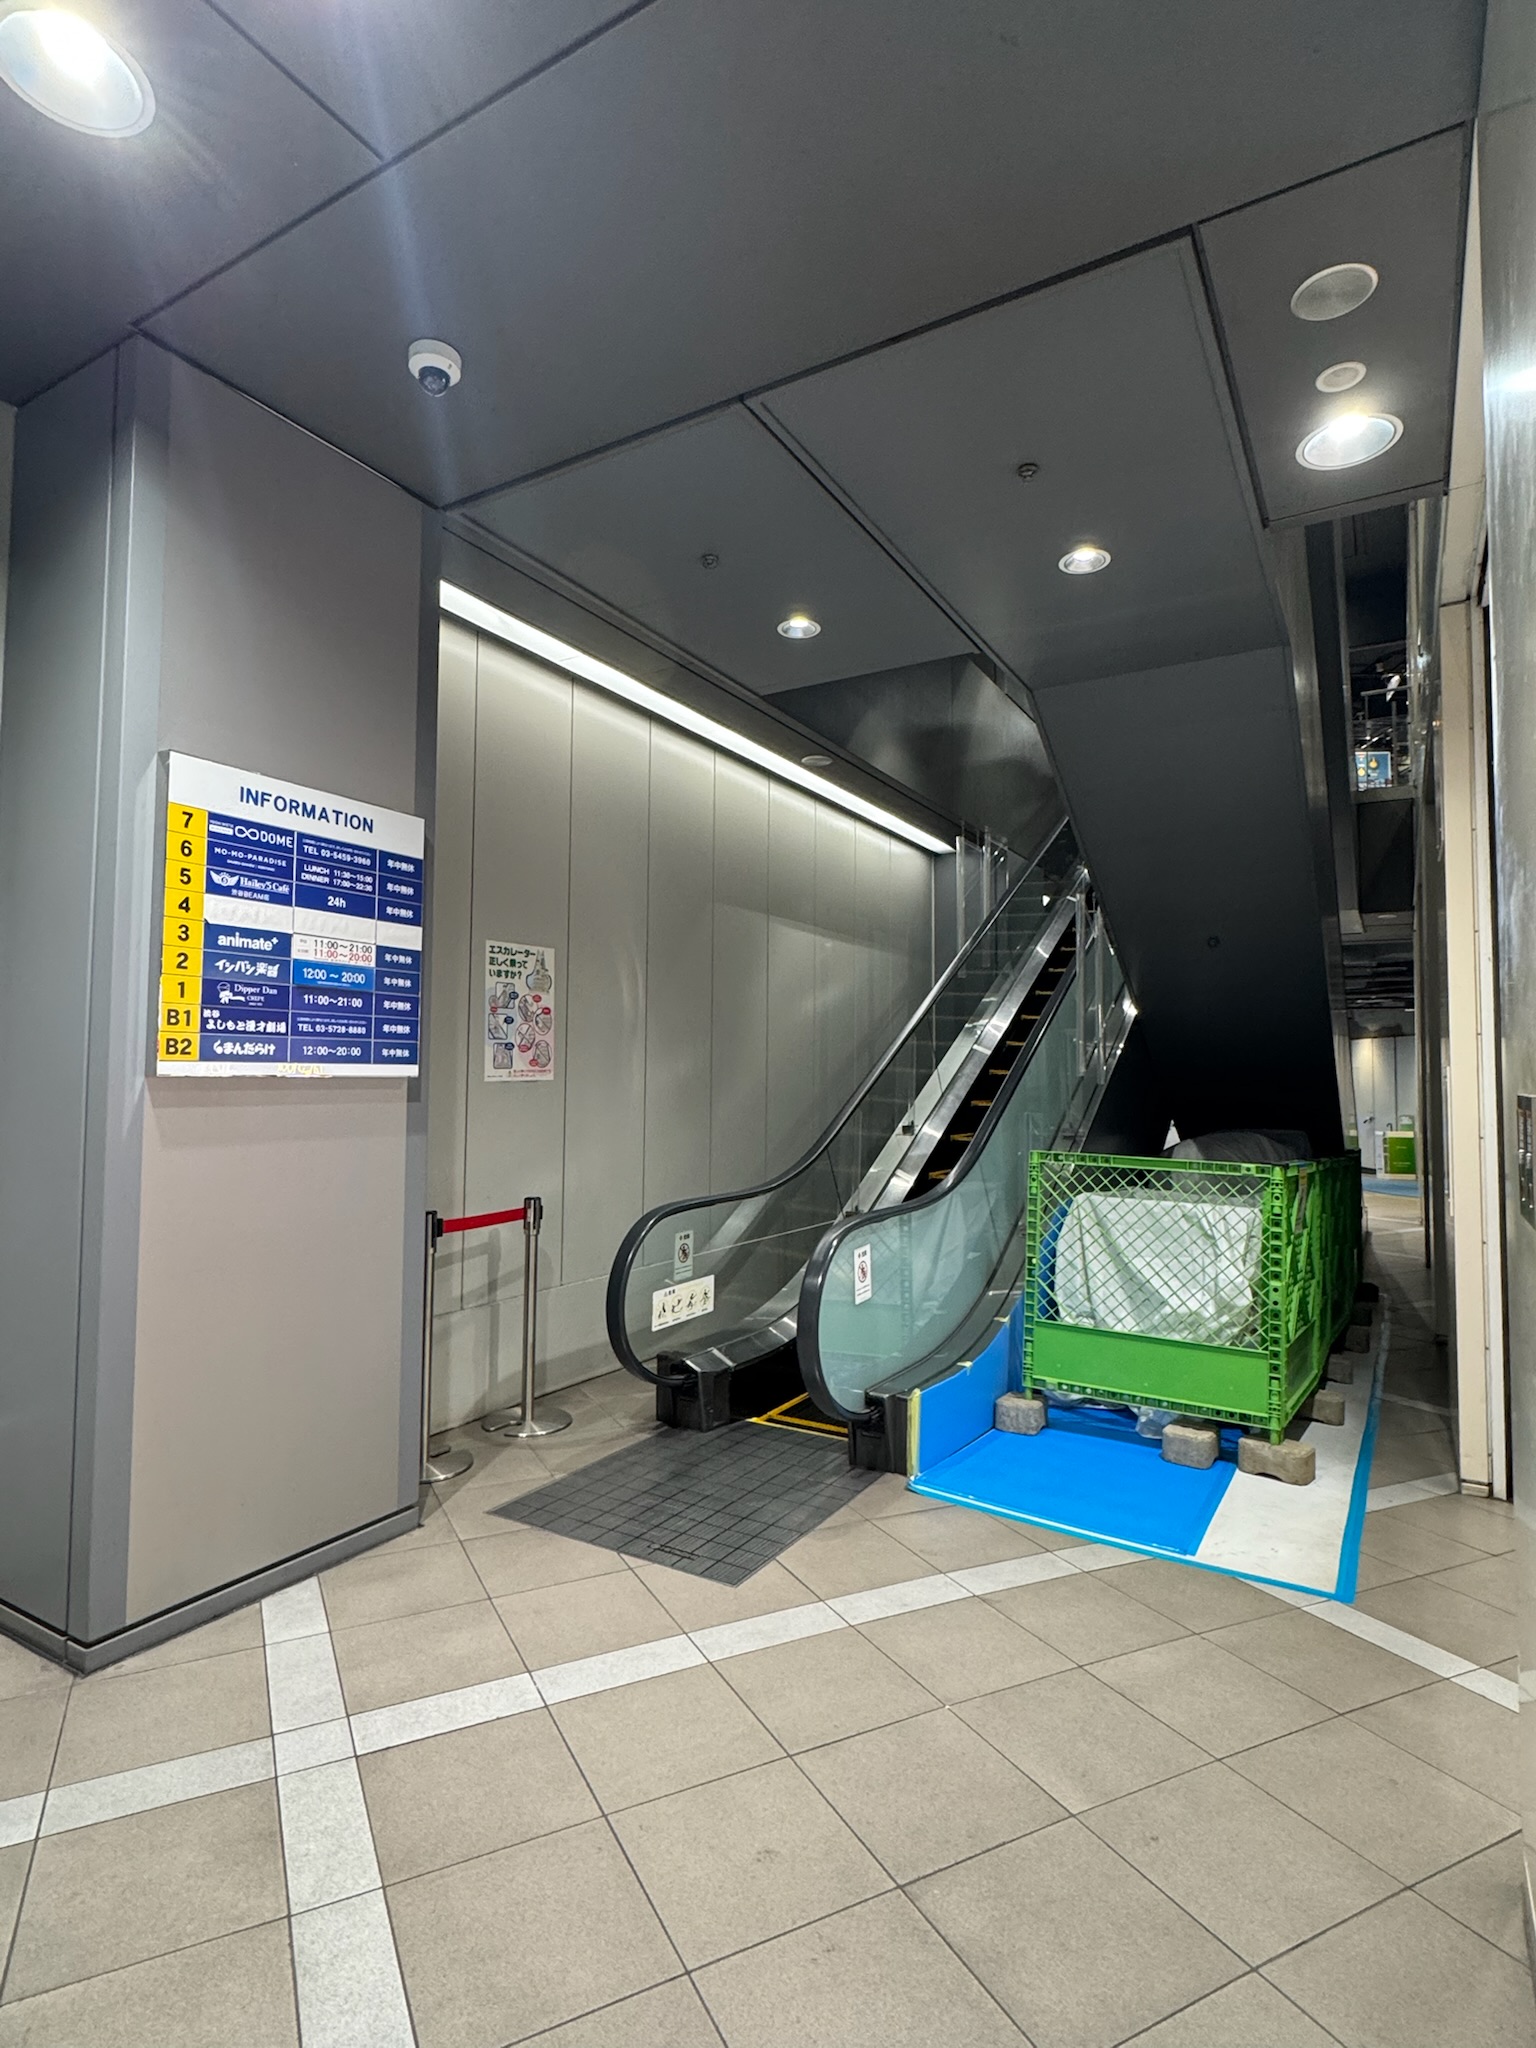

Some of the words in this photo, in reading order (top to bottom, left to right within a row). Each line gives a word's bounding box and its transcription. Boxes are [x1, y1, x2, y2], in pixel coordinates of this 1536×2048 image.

[239, 786, 374, 834] INFORMATION
[182, 811, 194, 829] 7
[180, 840, 193, 858] 6
[214, 847, 287, 867] MO-MO-PARADISE
[303, 845, 321, 856] TEL
[179, 868, 192, 885] 5
[303, 864, 330, 875] LUNCH
[301, 873, 330, 884] DINNER
[178, 896, 191, 913] 4
[327, 895, 347, 908] 24h
[177, 924, 190, 942] 3
[488, 945, 537, 958] エスカレーター
[176, 952, 189, 970] 2
[488, 956, 529, 970] 正しく乗って
[177, 981, 186, 999] 1
[234, 984, 261, 996] Dipper
[262, 986, 278, 995] Dan
[166, 1008, 191, 1027] B1
[298, 1023, 313, 1032] TEL
[165, 1038, 192, 1056] B2
